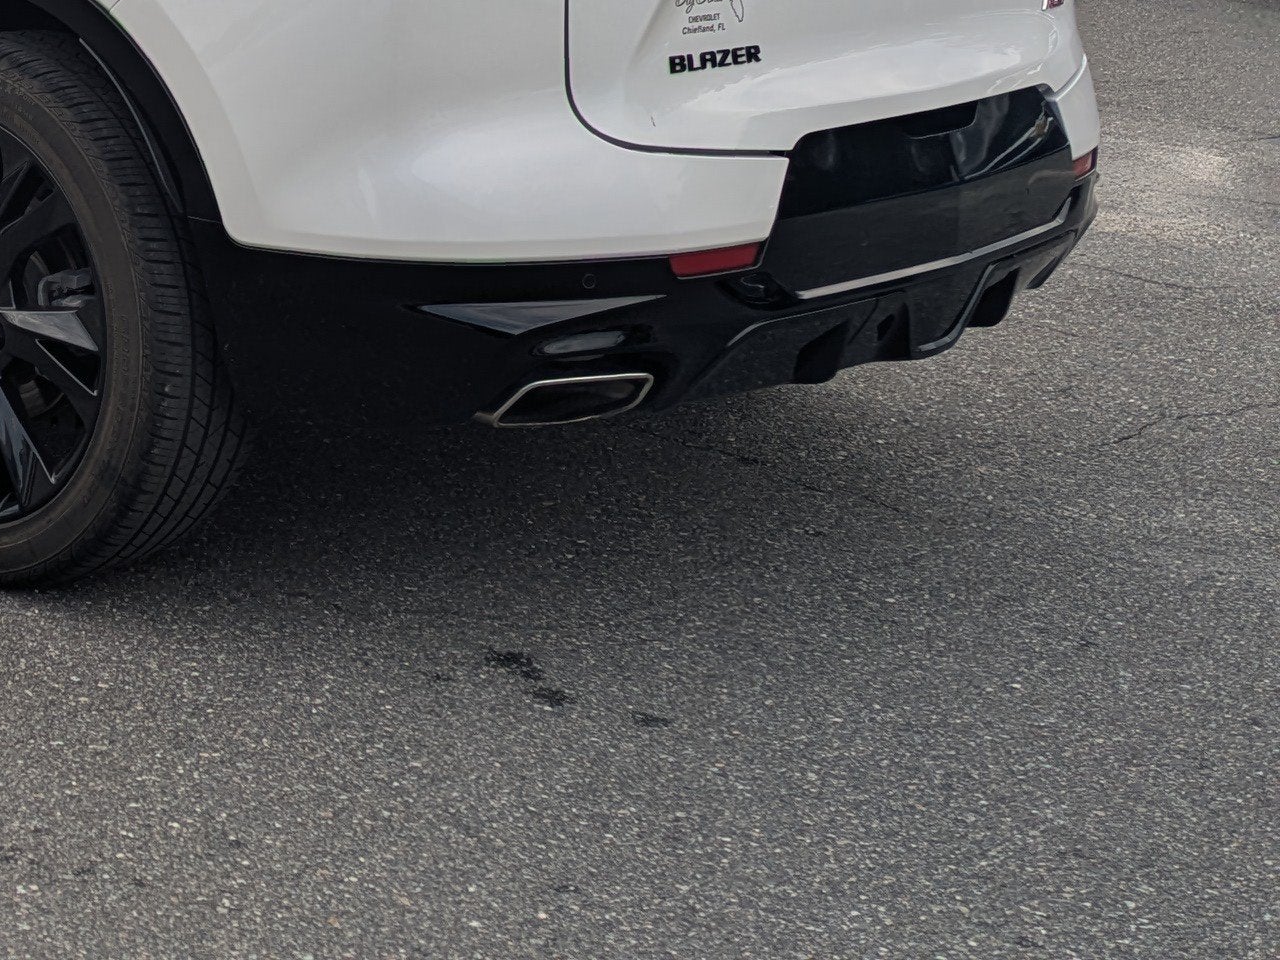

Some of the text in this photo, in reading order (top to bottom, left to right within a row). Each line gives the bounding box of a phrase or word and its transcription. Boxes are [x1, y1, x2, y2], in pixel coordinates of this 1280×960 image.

[688, 13, 720, 23] CHEVROLET
[717, 22, 726, 31] FL
[668, 44, 762, 74] BLAZER
